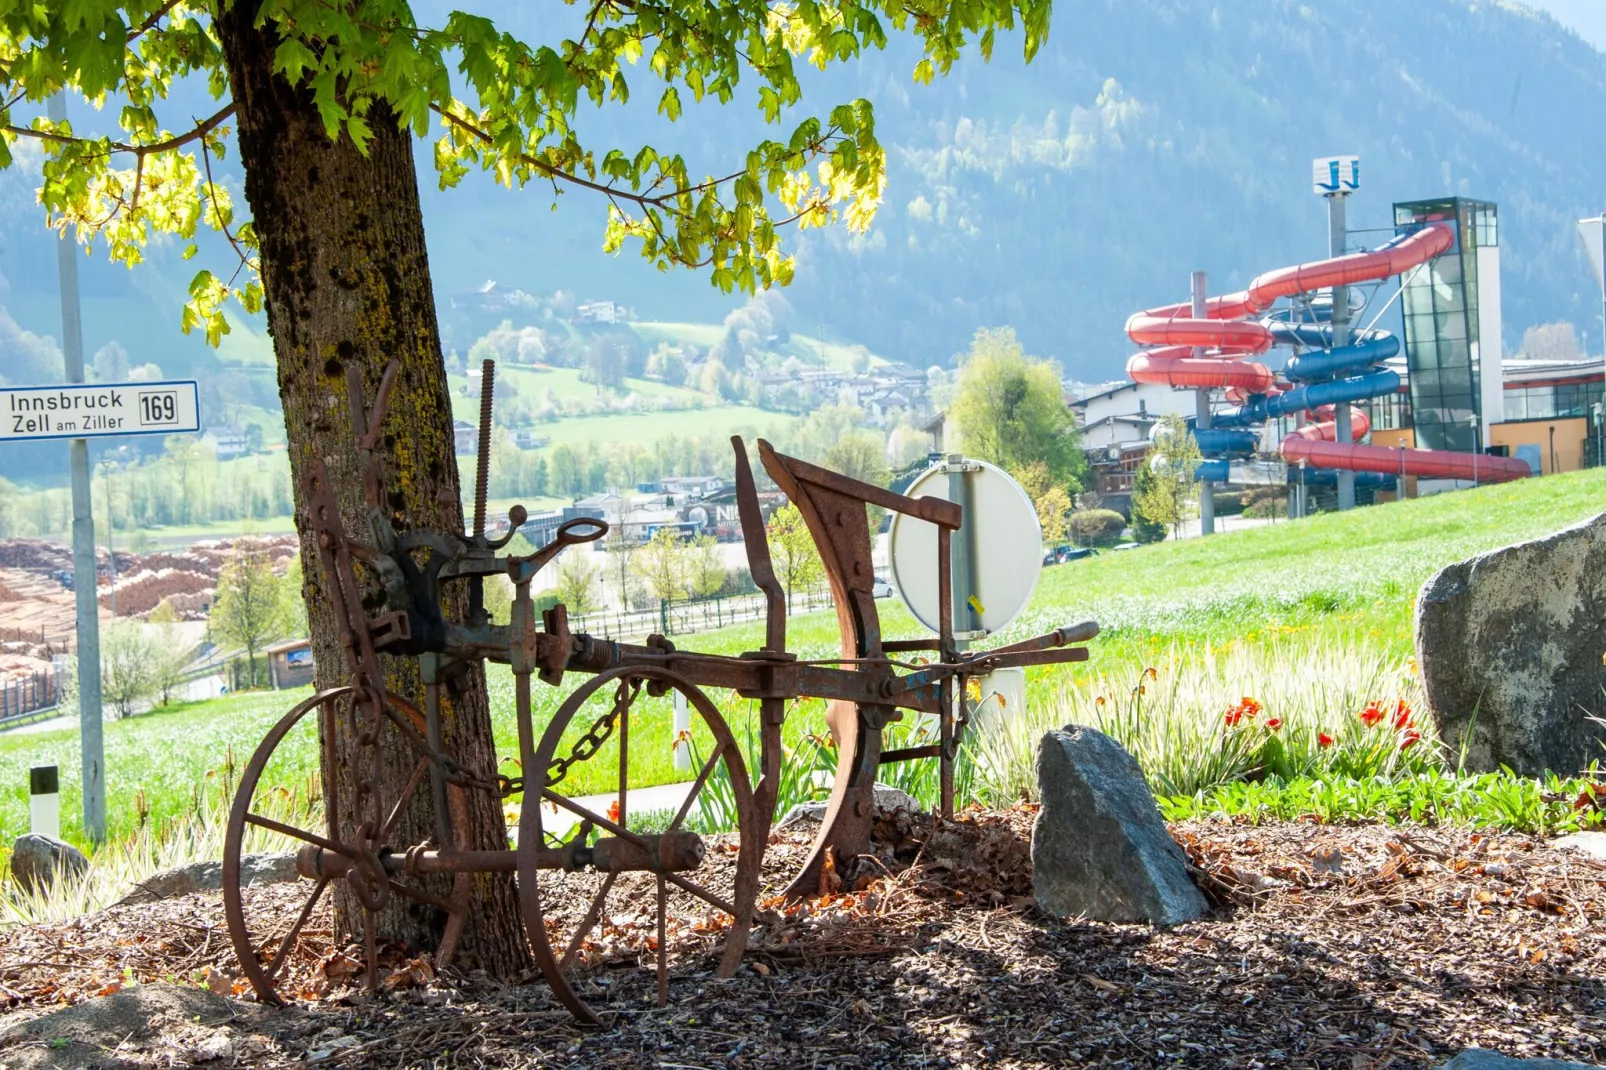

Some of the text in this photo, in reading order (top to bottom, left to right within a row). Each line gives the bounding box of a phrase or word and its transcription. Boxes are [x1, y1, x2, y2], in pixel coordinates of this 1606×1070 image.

[11, 390, 123, 412] Innsbruck
[141, 395, 175, 421] 169
[12, 414, 124, 433] Zell am Ziller
